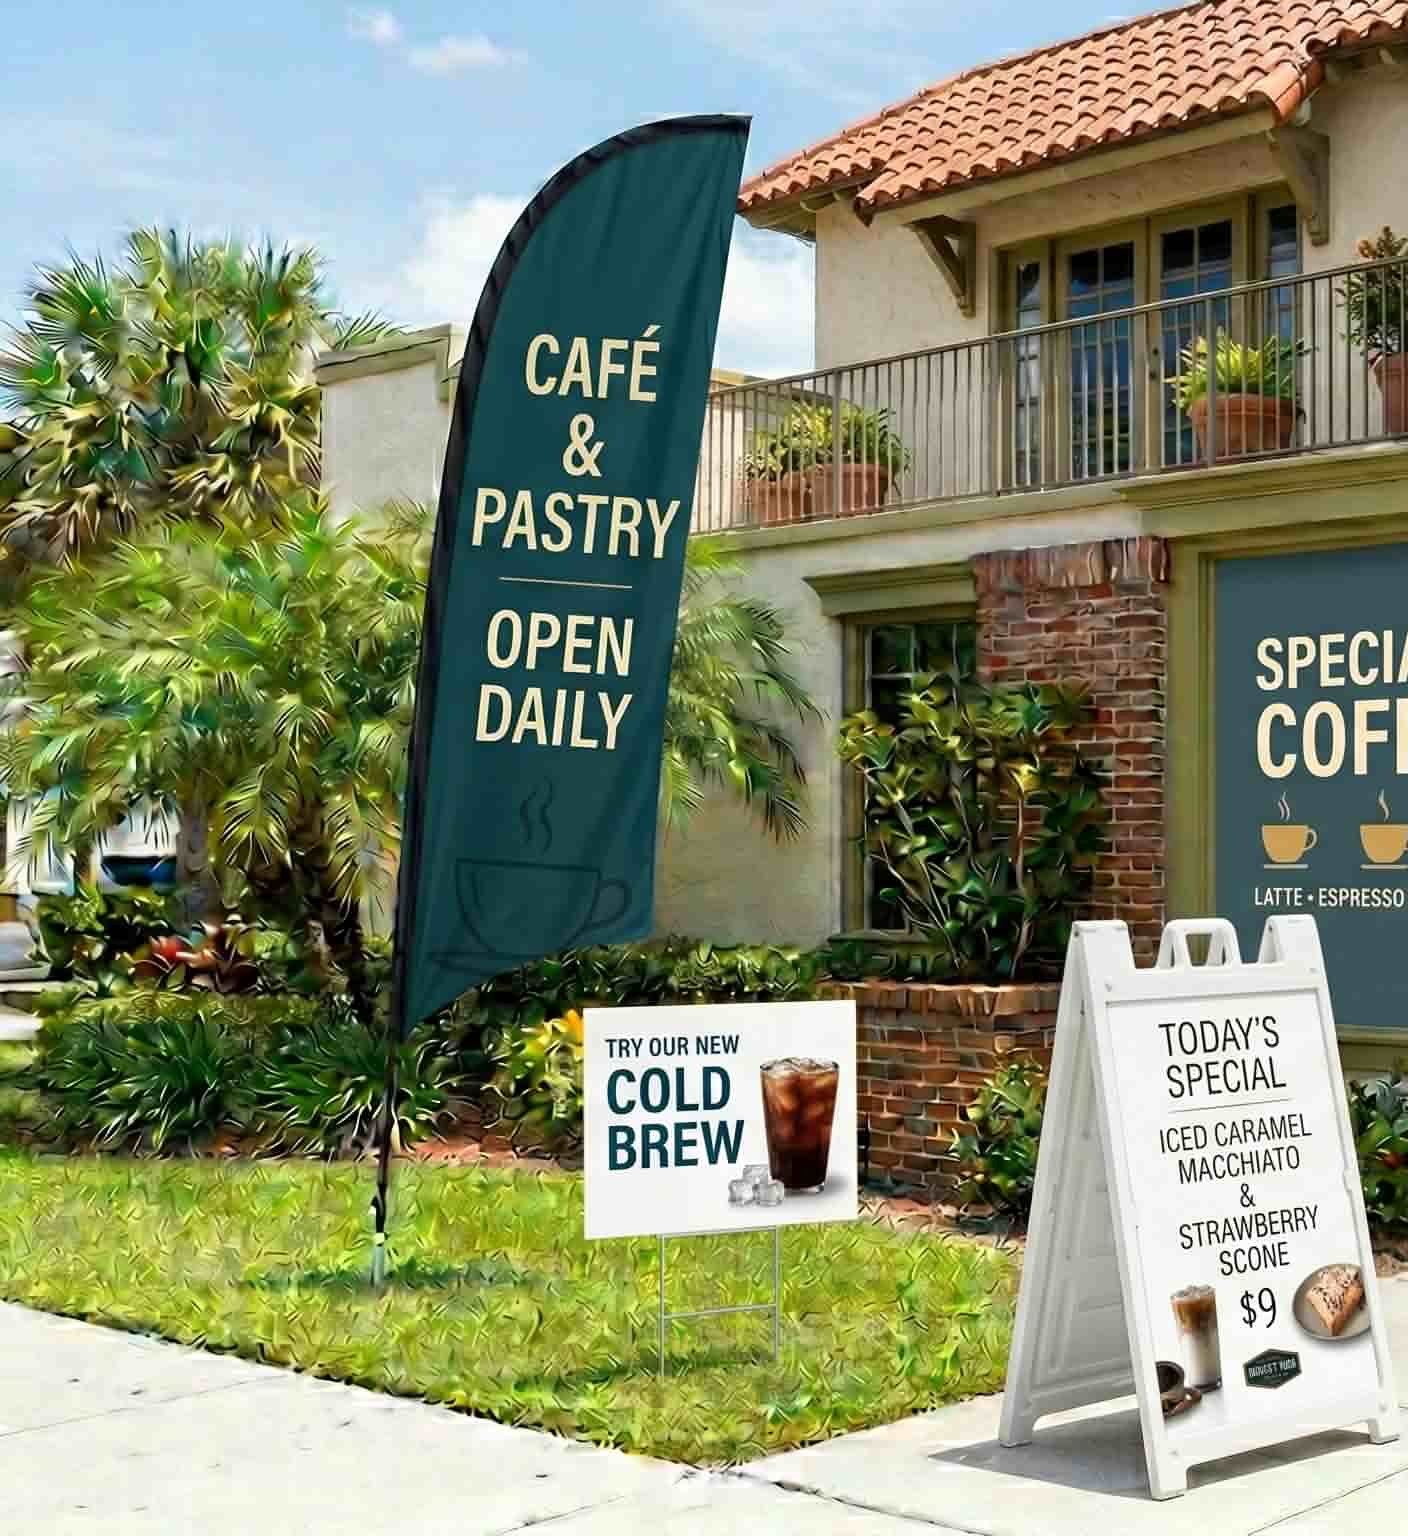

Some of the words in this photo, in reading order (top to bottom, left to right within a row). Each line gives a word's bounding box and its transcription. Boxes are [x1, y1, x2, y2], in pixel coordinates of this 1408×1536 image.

[525, 324, 662, 402] CAFÉ
[563, 413, 605, 477] &
[472, 487, 681, 559] PASTRY
[487, 609, 634, 677] OPEN
[475, 683, 633, 750] DAILY
[1254, 887, 1303, 907] LATTE
[1318, 887, 1405, 908] ESPRESSO
[604, 1037, 644, 1059] TRY
[649, 1036, 689, 1057] OUR
[695, 1034, 740, 1056] NEW
[1157, 1015, 1280, 1057] TODAY'S
[607, 1065, 731, 1115] COLD
[1166, 1055, 1287, 1099] SPECIAL
[608, 1119, 745, 1171] BREW
[1159, 1124, 1208, 1154] ICED
[1214, 1112, 1313, 1147] CARAMEL
[1178, 1145, 1300, 1185] MACCHIATO
[1239, 1183, 1257, 1208] &
[1179, 1204, 1319, 1250] STRAWBERRY
[1219, 1241, 1291, 1277] SCONE
[1240, 1287, 1277, 1329] $9
